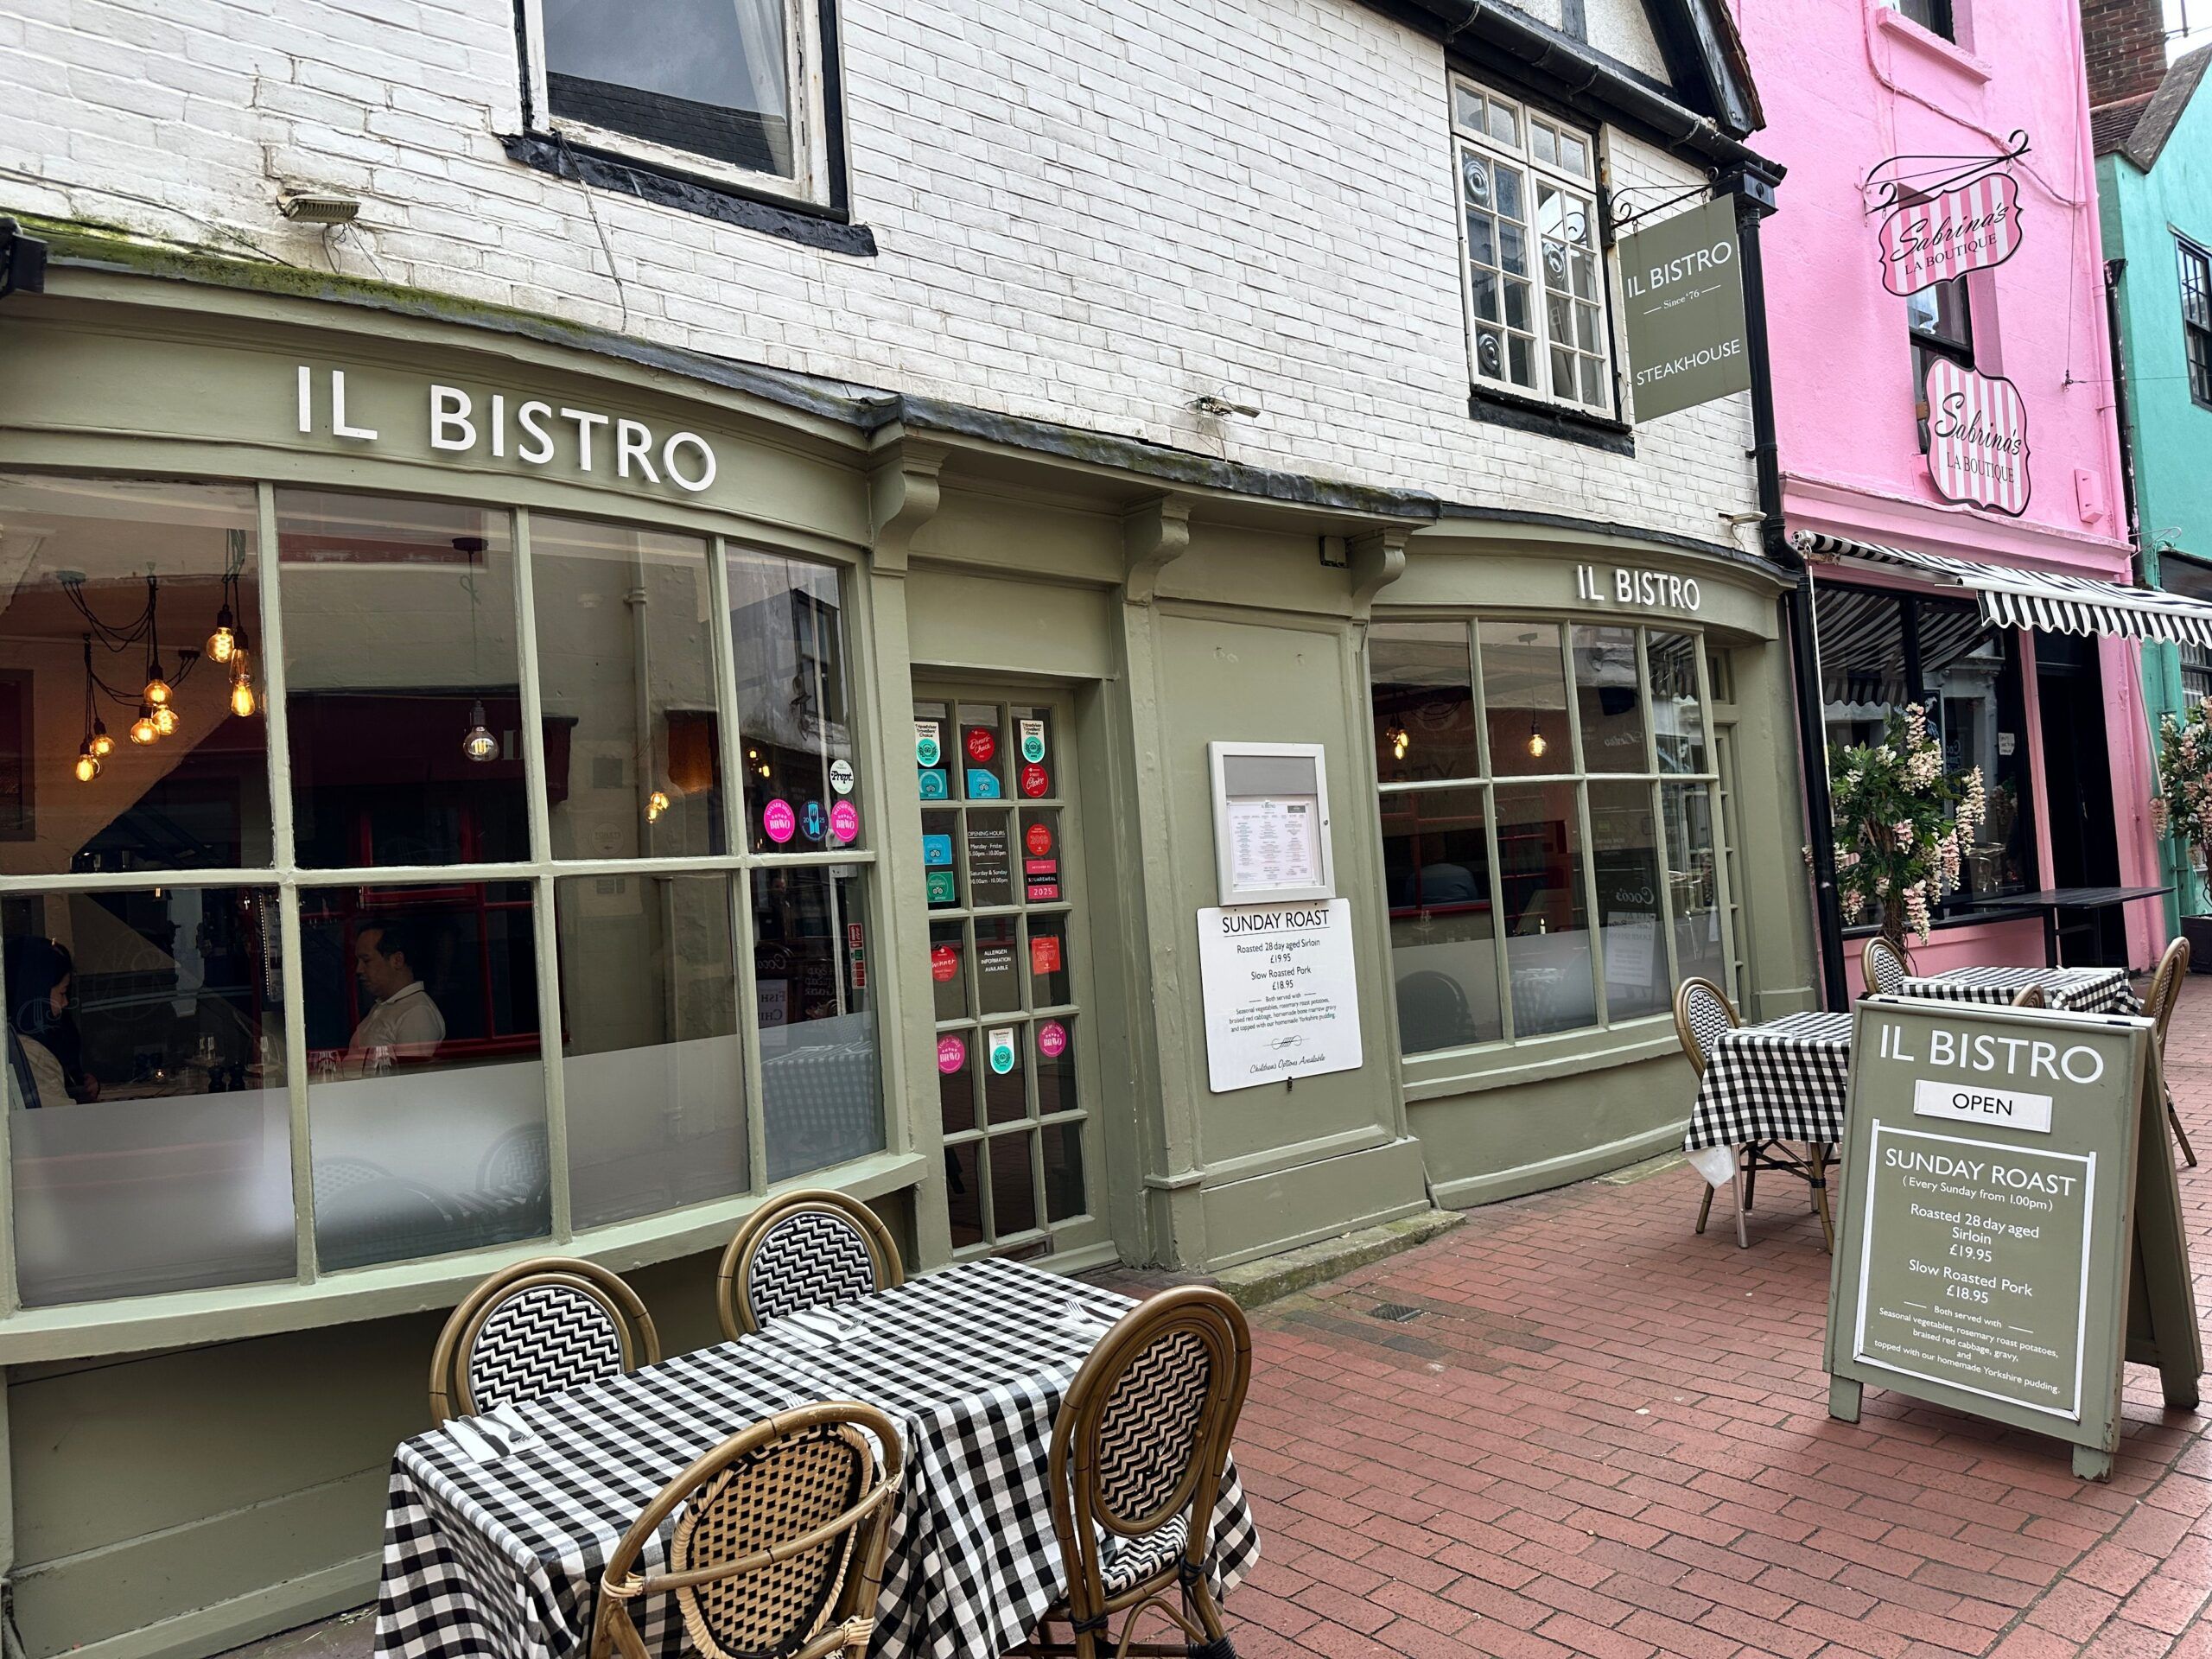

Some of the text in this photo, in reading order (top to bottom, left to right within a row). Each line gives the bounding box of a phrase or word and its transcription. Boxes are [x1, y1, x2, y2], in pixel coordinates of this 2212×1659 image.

[1890, 202, 2009, 262] Sabrina's
[1627, 241, 1732, 298] IL BISTRO
[1905, 233, 1997, 275] LA BOUTIQUE
[1663, 295, 1686, 309] Since
[1637, 339, 1740, 386] STEAKHOUSE
[298, 365, 717, 493] IL BISTRO
[1934, 392, 2022, 455] Sabrina's
[1948, 451, 2014, 484] LA BOUTIQUE
[1578, 565, 1700, 611] IL BISTRO
[1222, 909, 1329, 933] SUNDAY ROAST
[1237, 938, 1320, 954] Roasted 28 day aged Sirloin
[1251, 964, 1312, 980] Slow Roasted Pork
[1272, 980, 1294, 990] £18.95
[1279, 1001, 1299, 1009] rosemary
[1278, 1059, 1298, 1070] Options
[1298, 1053, 1325, 1065] Available
[1880, 1024, 2104, 1084] IL BISTRO
[1952, 1092, 2012, 1116] OPEN
[1885, 1147, 2077, 1197] SUNDAY ROAST
[1940, 1182, 1978, 1200] Sunday
[1979, 1189, 2005, 1203] from
[1911, 1204, 2039, 1238] Roasted 28 day aged
[1952, 1227, 1991, 1245] Sirloin
[1949, 1243, 1992, 1262] £19.95
[1909, 1259, 2033, 1297] Slow Roasted Pork
[1946, 1284, 1989, 1304] £18.95
[1879, 1307, 2058, 1358] Seasonal vegetables, rosemary roast potatoes,
[1934, 1305, 2002, 1328] Both served with
[1913, 1328, 2018, 1363] braised red cabbage, gravy,
[1956, 1351, 1972, 1360] and
[1874, 1339, 2061, 1395] topped with our homemade Yorkshire pudding.
